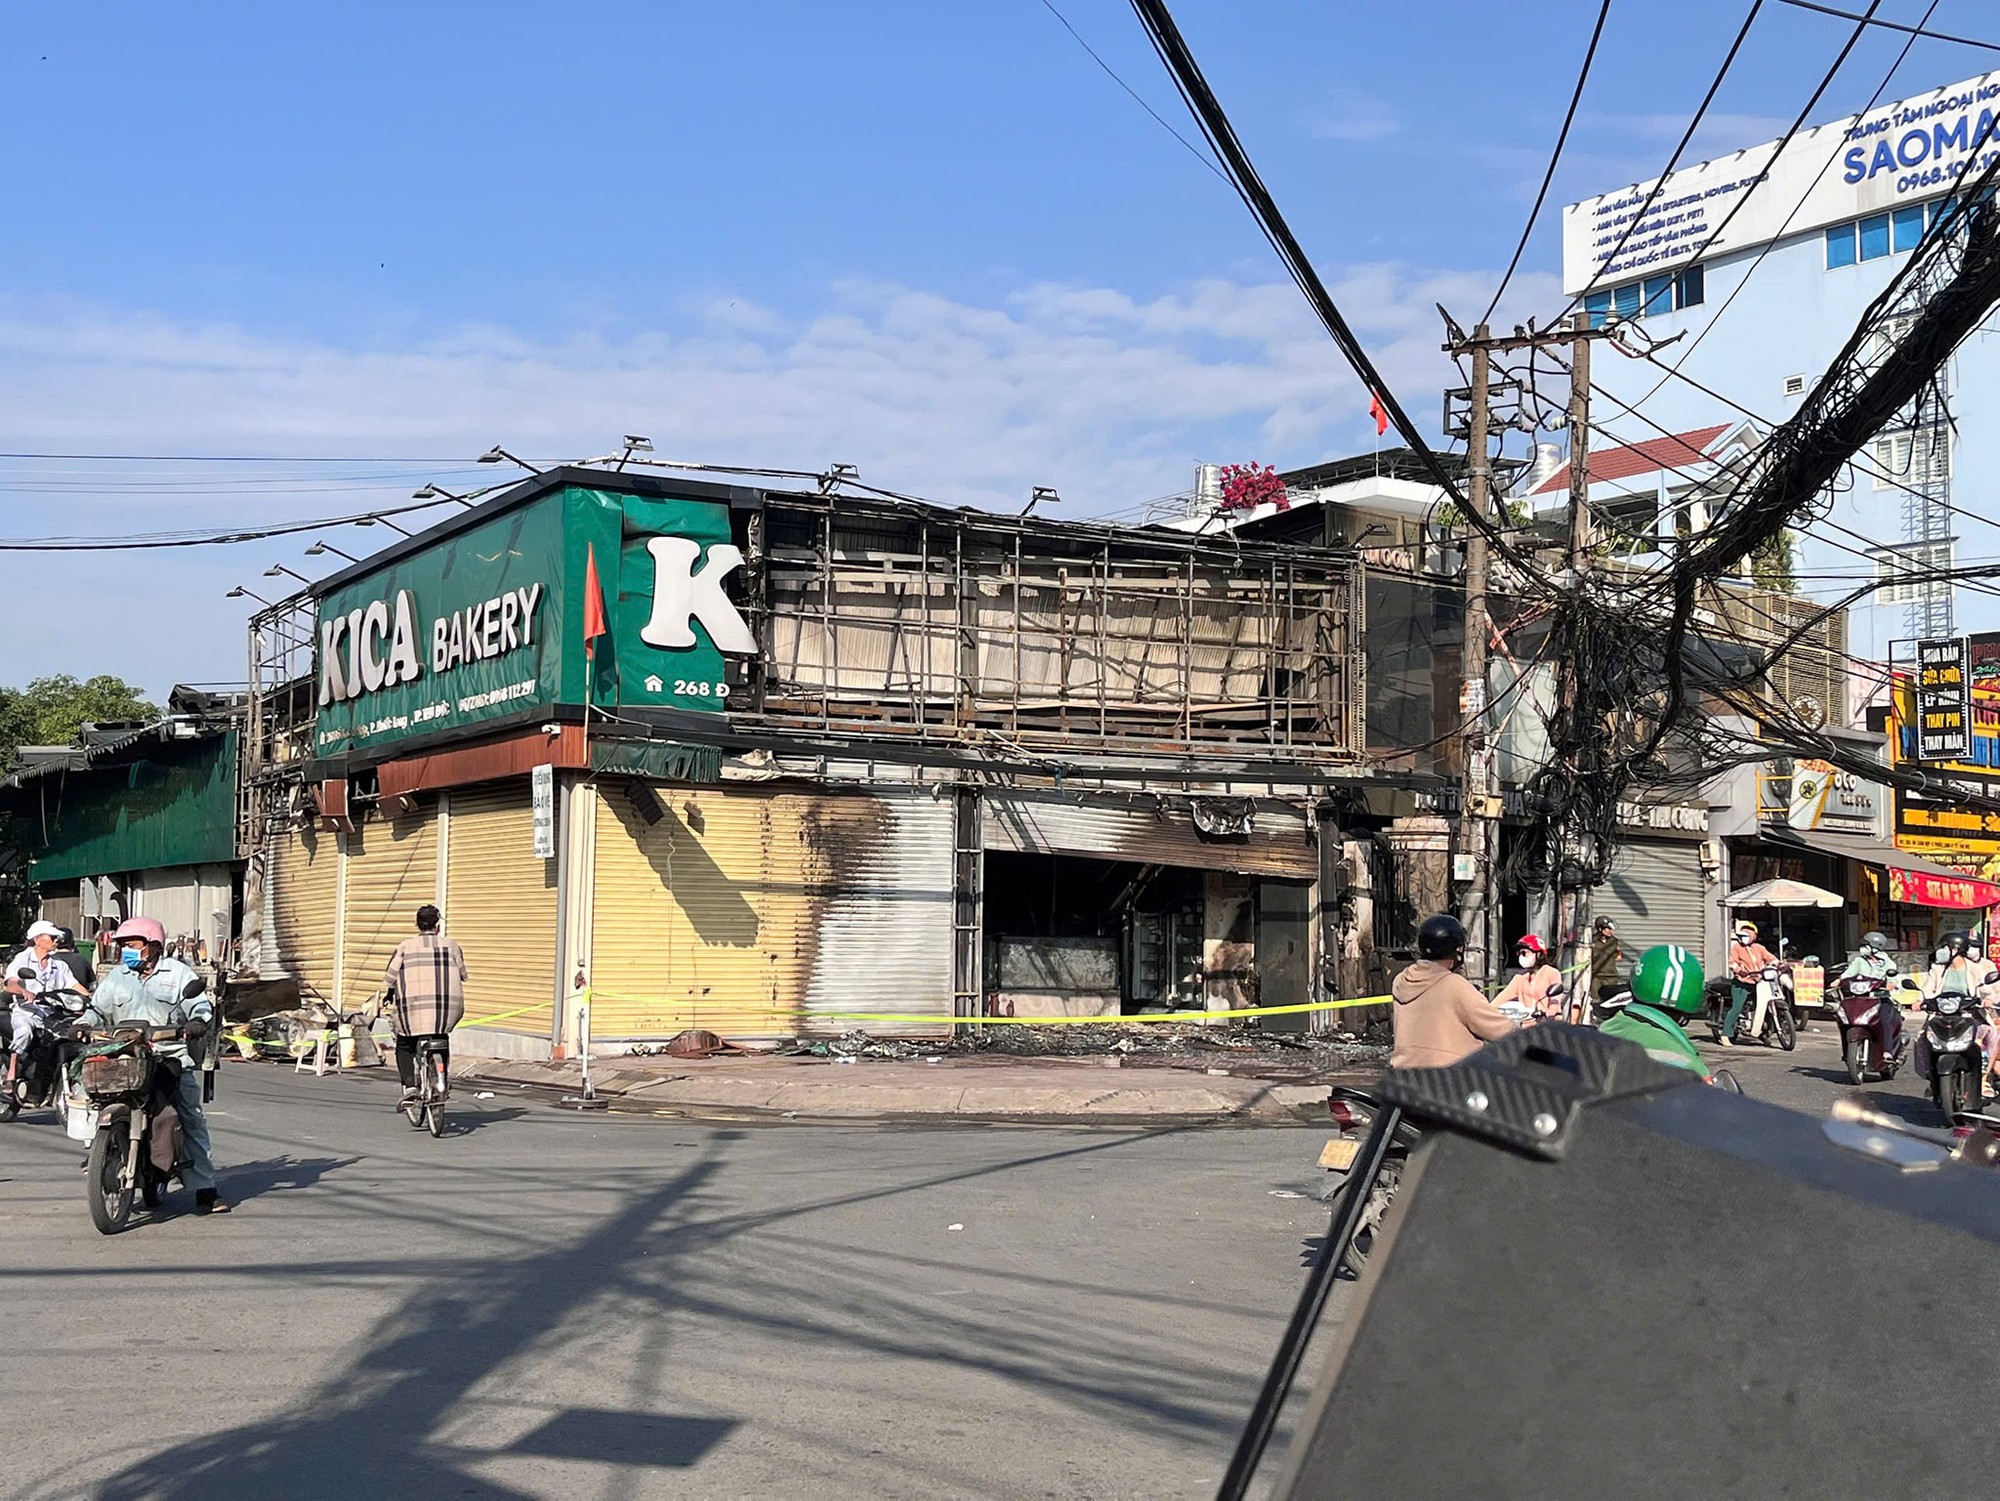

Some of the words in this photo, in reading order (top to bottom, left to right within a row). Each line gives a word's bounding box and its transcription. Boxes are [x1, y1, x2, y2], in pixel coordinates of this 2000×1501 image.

[1844, 118, 1890, 142] TRUNG
[1892, 107, 1923, 128] TÂM
[1924, 91, 1974, 119] NGOẠI
[640, 537, 759, 654] K
[318, 589, 421, 707] KICA
[432, 582, 543, 674] BAKERY
[673, 679, 711, 697] 268
[1925, 713, 1944, 728] THAY
[1946, 712, 1960, 727] PIN
[1924, 735, 1943, 751] THAY
